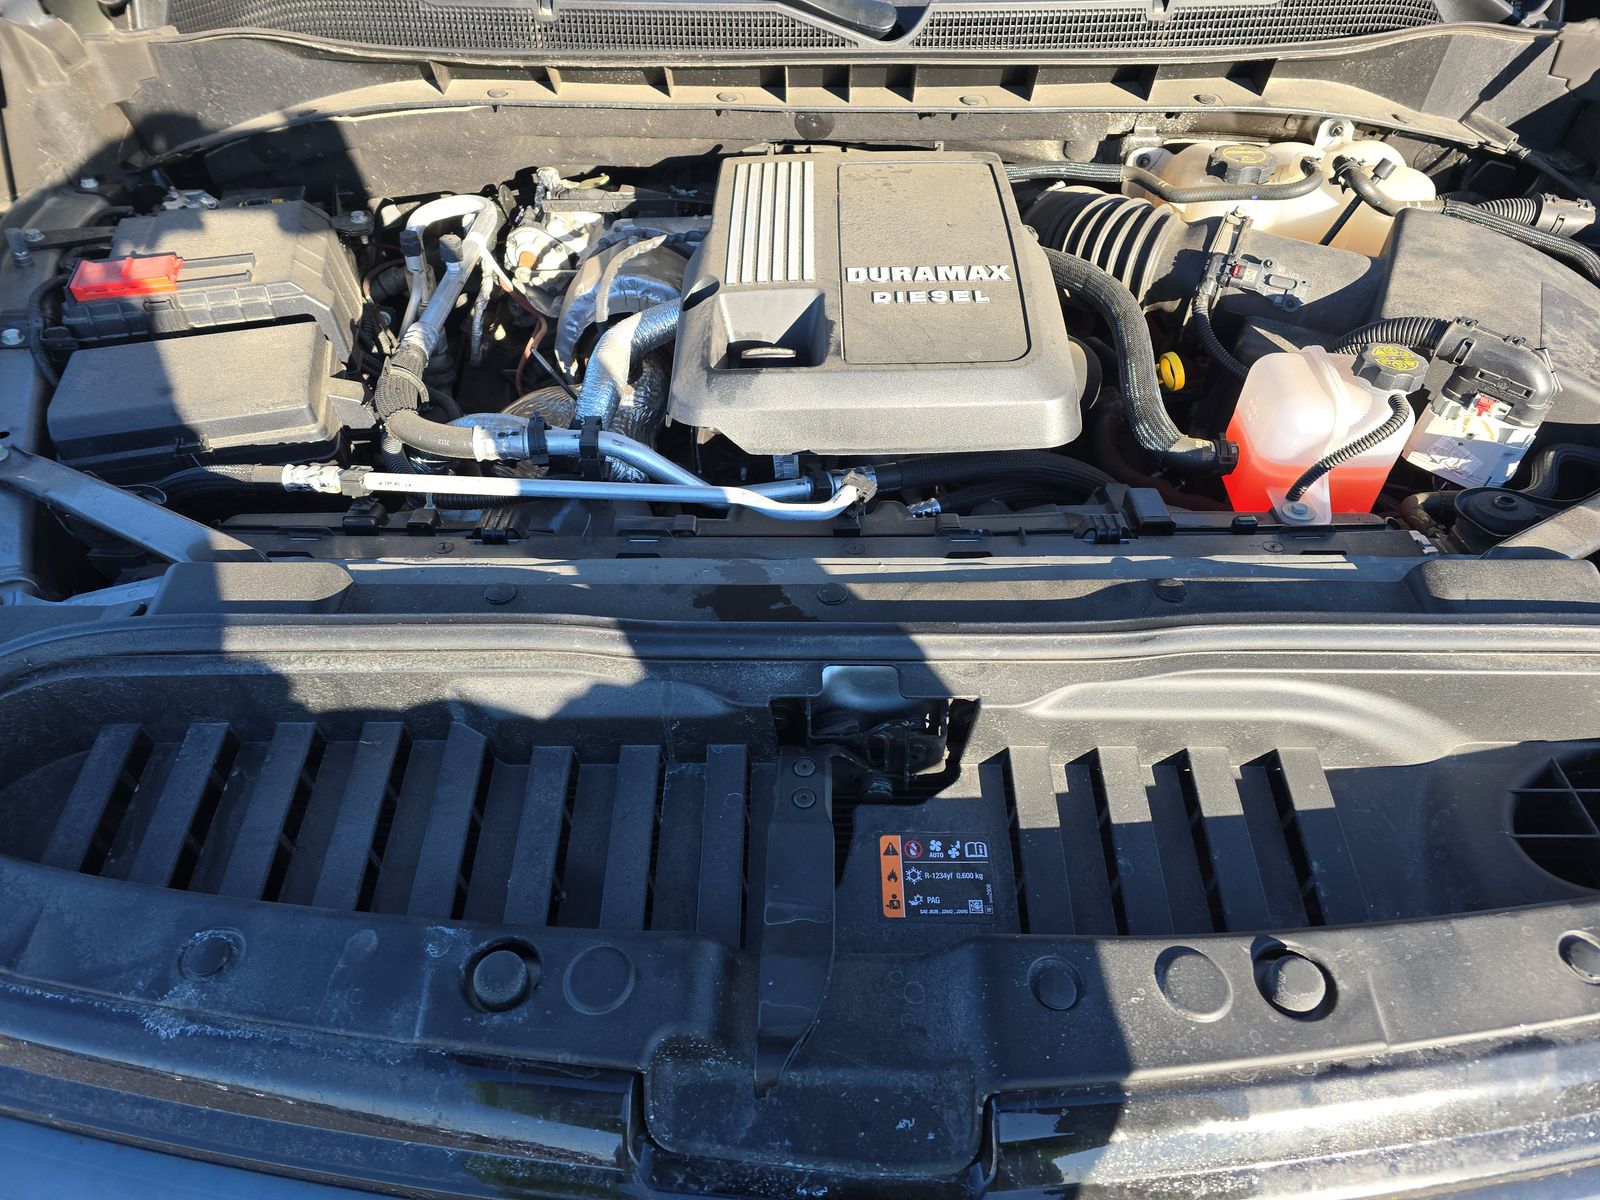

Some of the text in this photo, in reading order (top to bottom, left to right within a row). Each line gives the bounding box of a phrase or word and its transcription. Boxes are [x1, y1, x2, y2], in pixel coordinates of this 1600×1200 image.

[846, 265, 1012, 283] DURAMAX
[872, 289, 990, 305] DIESEL
[924, 872, 953, 881] R-1234yf
[975, 872, 984, 881] kg
[926, 896, 941, 904] PAG
